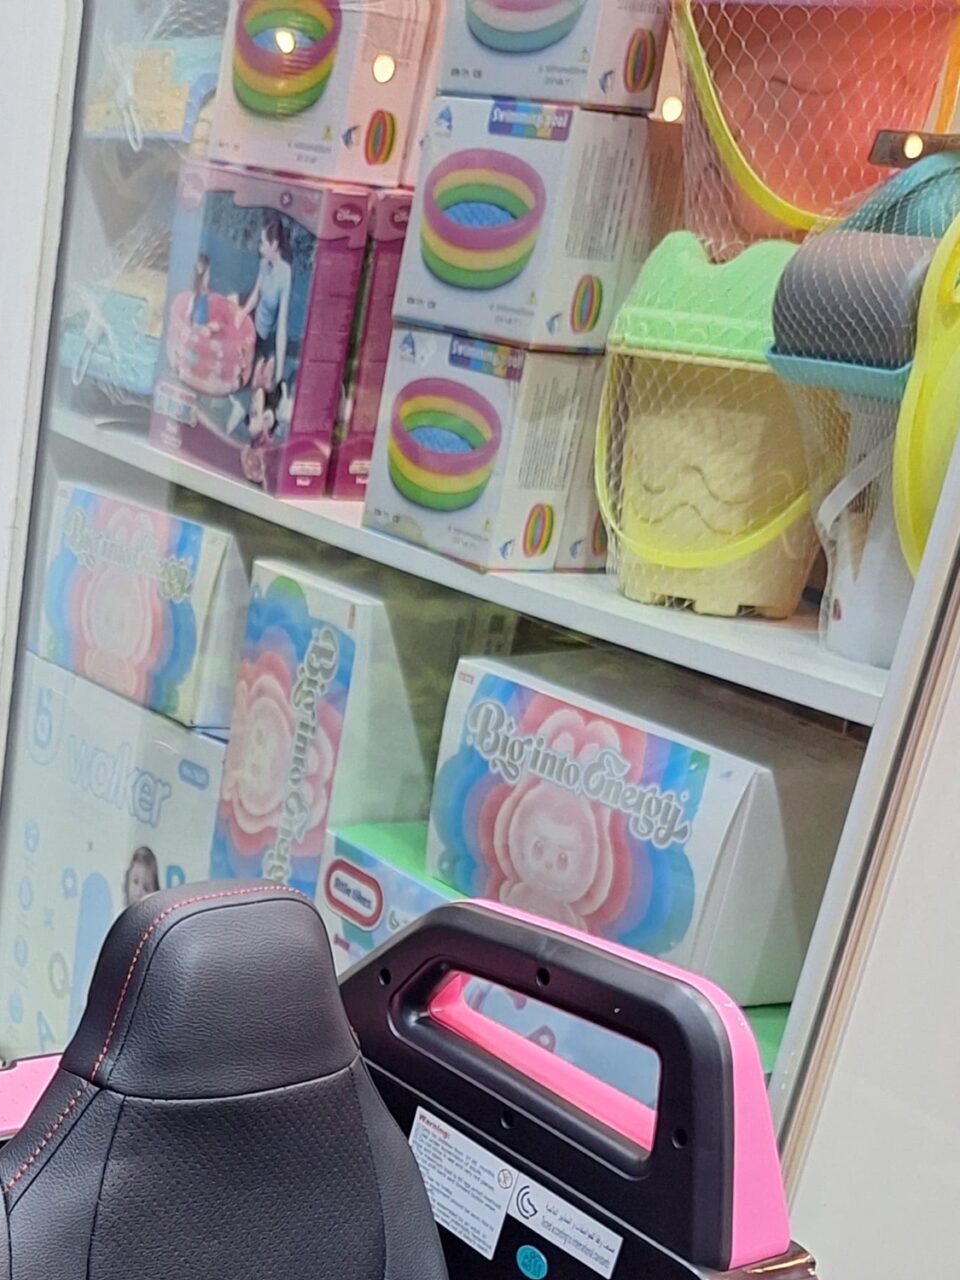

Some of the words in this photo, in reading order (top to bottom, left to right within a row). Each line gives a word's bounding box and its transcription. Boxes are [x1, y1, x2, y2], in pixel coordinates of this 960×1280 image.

[292, 628, 337, 722] Big
[66, 733, 173, 829] walker
[290, 720, 317, 786] into
[467, 699, 532, 784] Big
[528, 736, 581, 788] into
[581, 749, 690, 849] Energy
